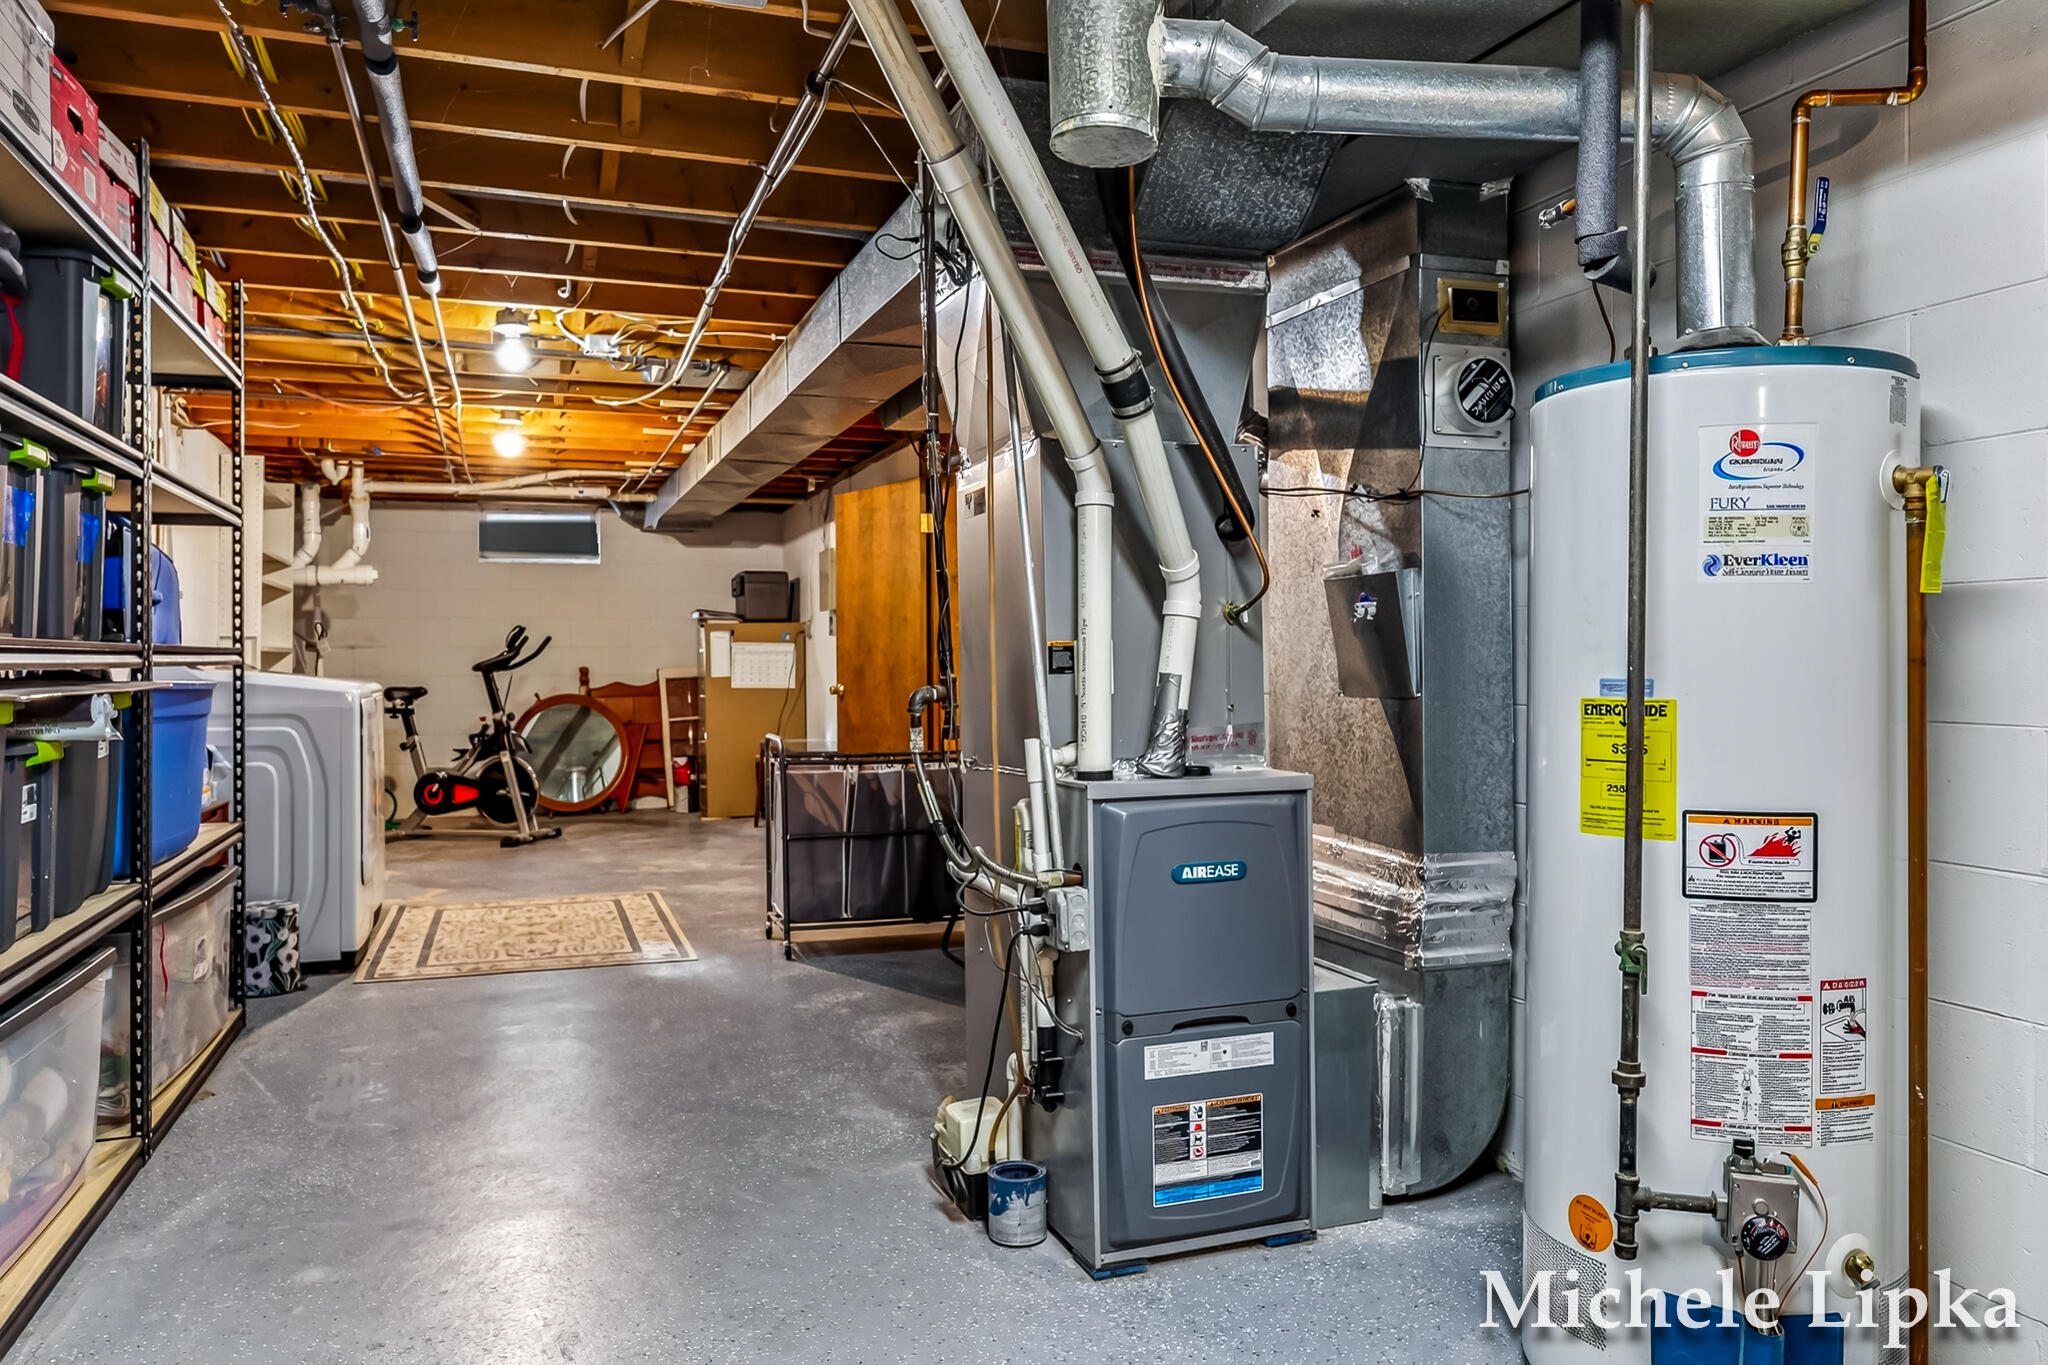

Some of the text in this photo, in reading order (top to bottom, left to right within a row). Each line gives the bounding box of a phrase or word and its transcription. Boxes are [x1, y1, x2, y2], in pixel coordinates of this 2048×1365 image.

[1710, 497, 1750, 509] FURY
[1723, 553, 1808, 566] EverKleen
[1181, 863, 1239, 879] AIREASE
